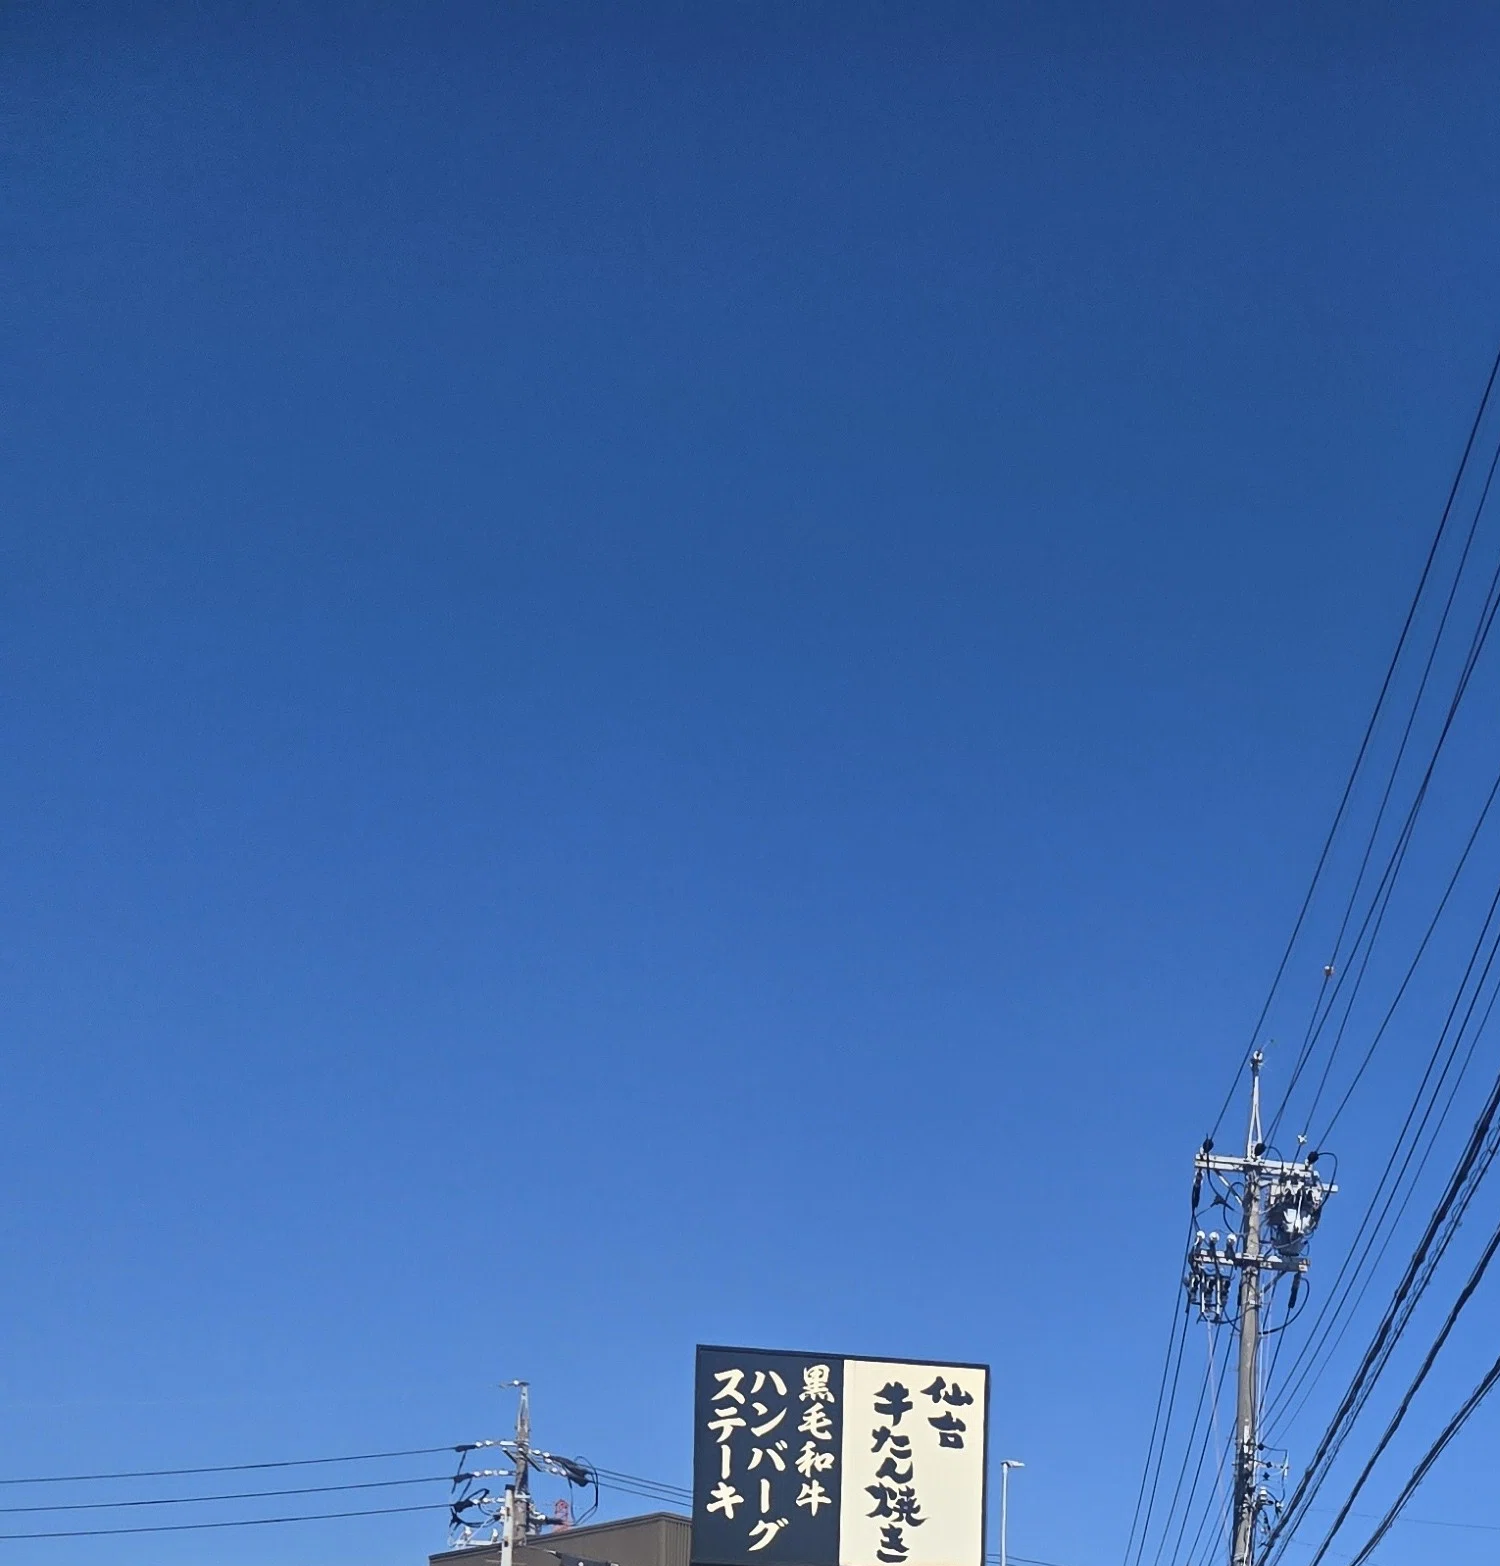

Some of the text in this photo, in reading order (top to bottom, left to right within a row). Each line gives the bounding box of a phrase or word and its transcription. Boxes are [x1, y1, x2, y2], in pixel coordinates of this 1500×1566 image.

[706, 1368, 747, 1520] ステーキ
[747, 1370, 789, 1552] ハンバーグ
[795, 1363, 836, 1517] 黒毛和牛
[865, 1380, 931, 1564] 牛たん焼き
[919, 1375, 974, 1450] 仙台
